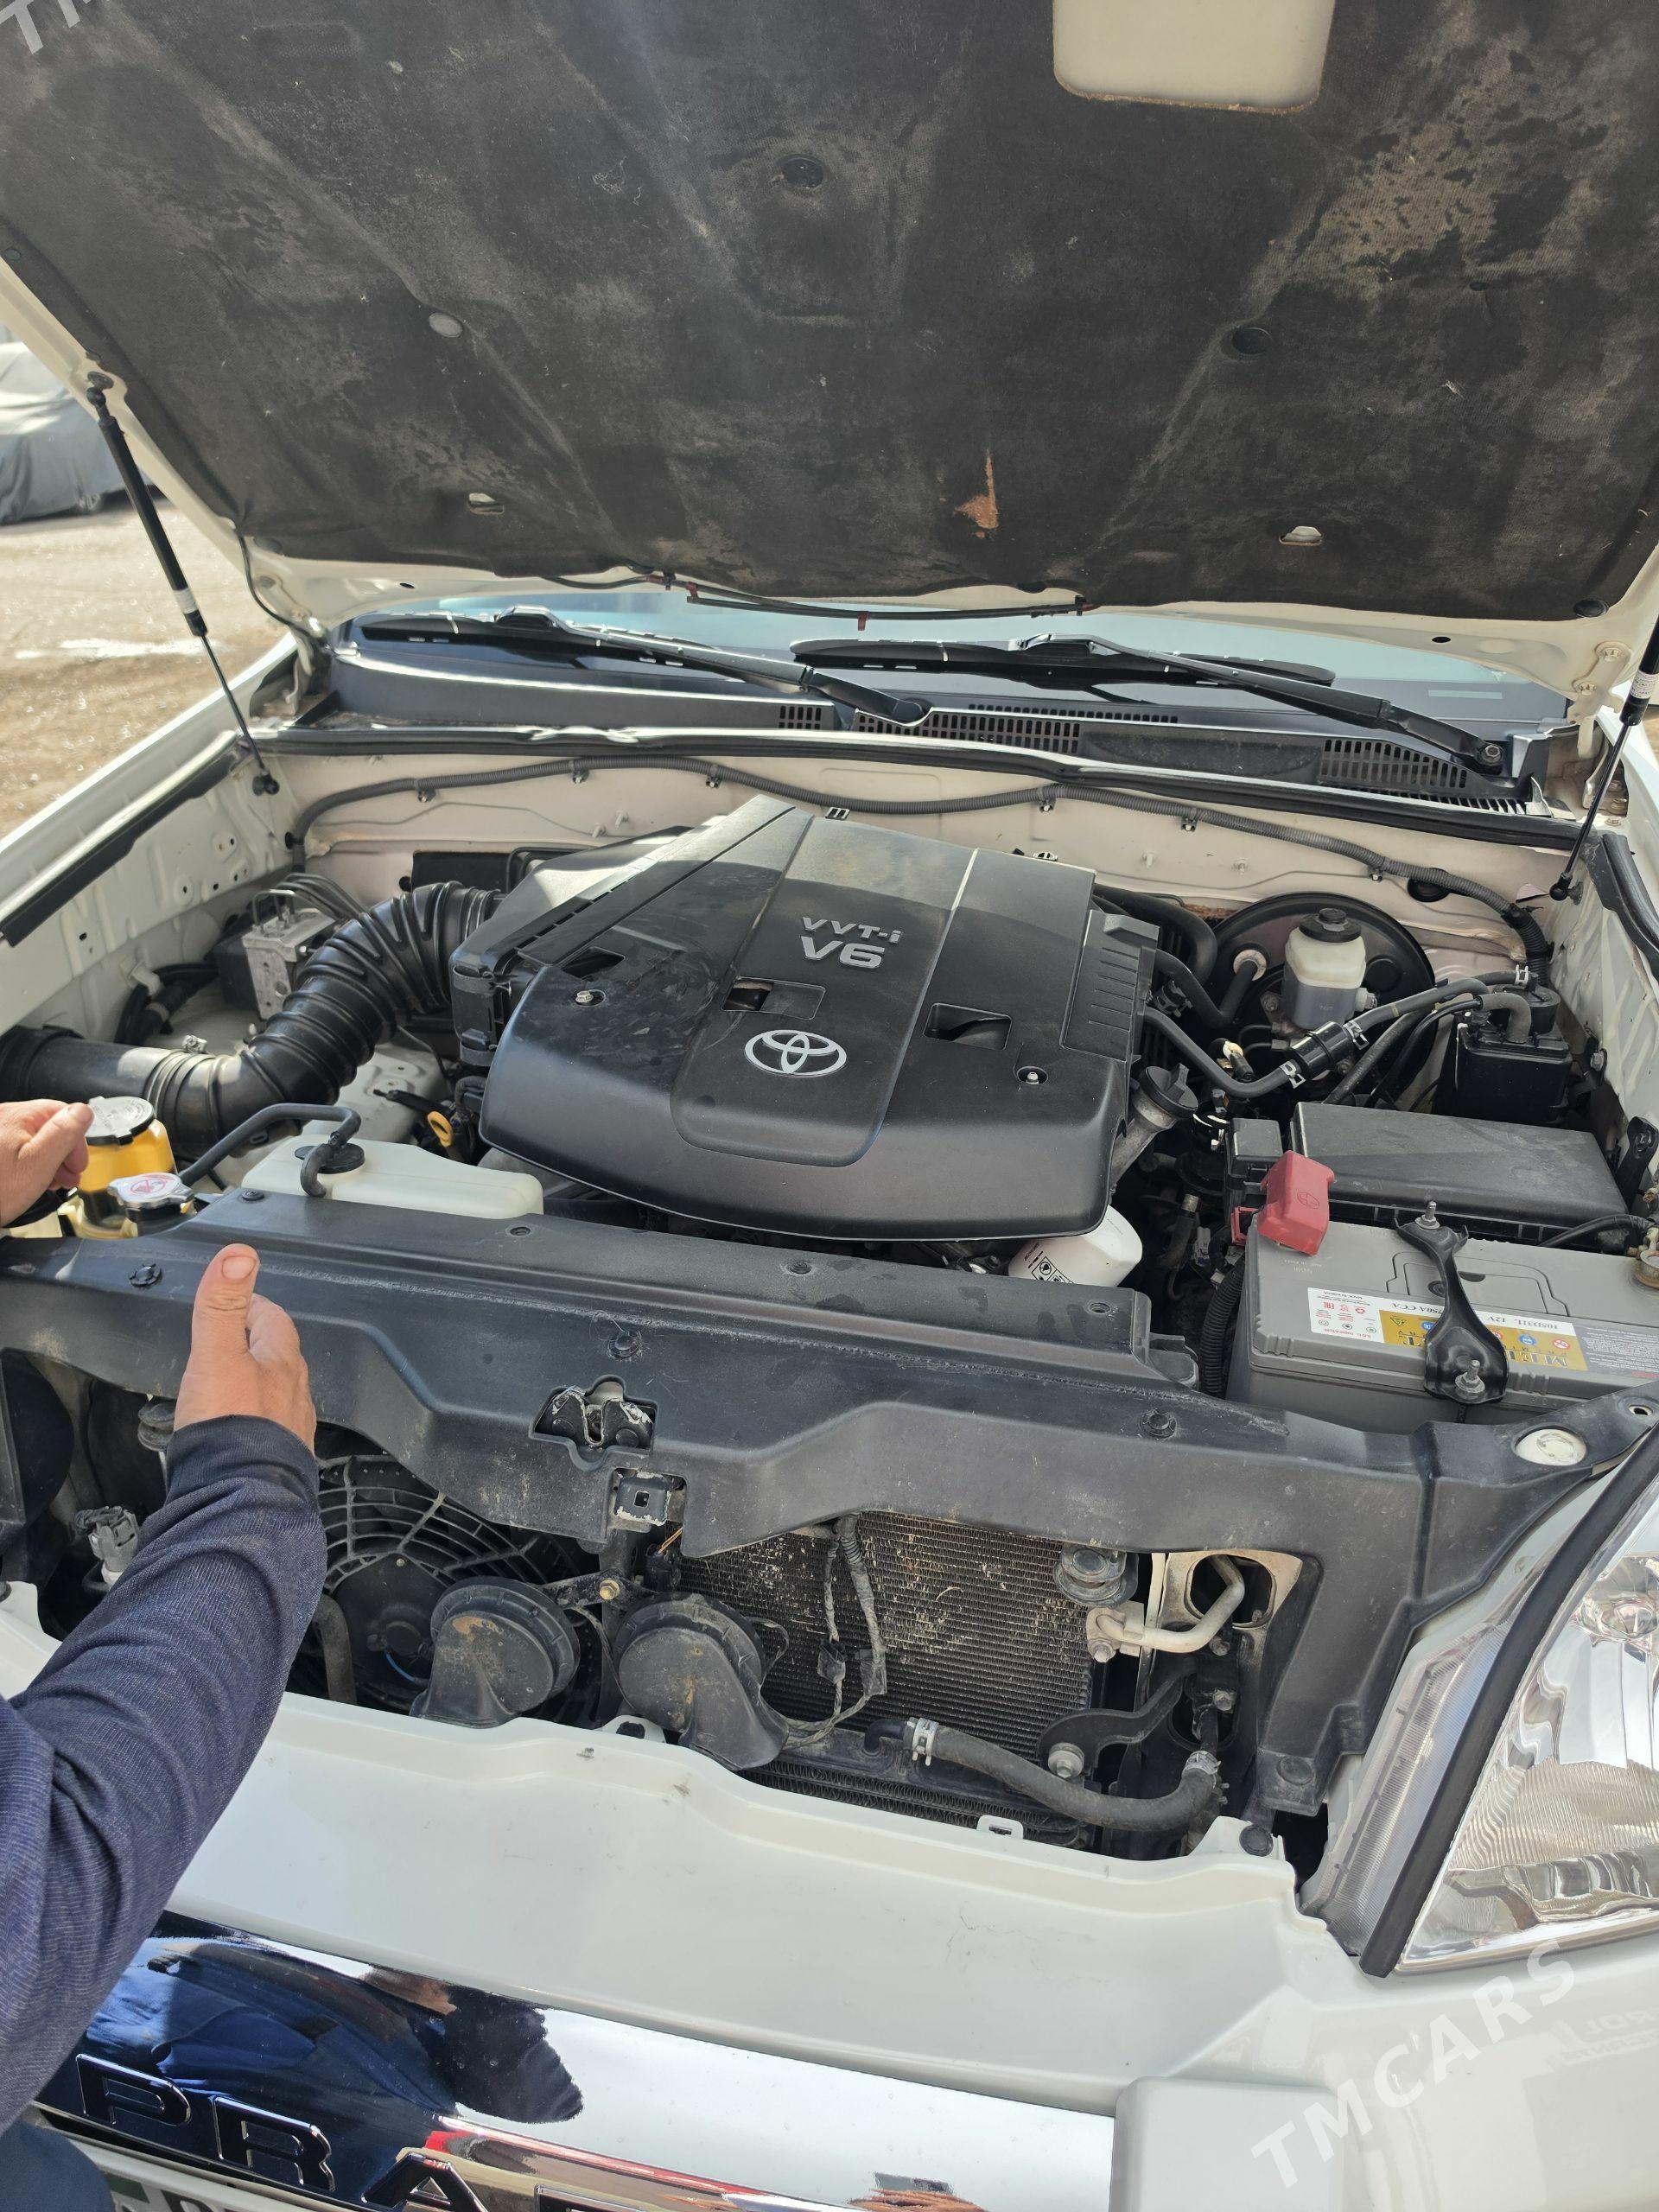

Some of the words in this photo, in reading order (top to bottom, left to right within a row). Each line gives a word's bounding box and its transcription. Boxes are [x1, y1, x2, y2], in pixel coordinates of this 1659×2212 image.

[802, 916, 904, 944] VVT-i
[800, 935, 886, 969] V6
[1391, 1302, 1416, 1311] CCA
[1513, 1319, 1559, 1330] 105D31L
